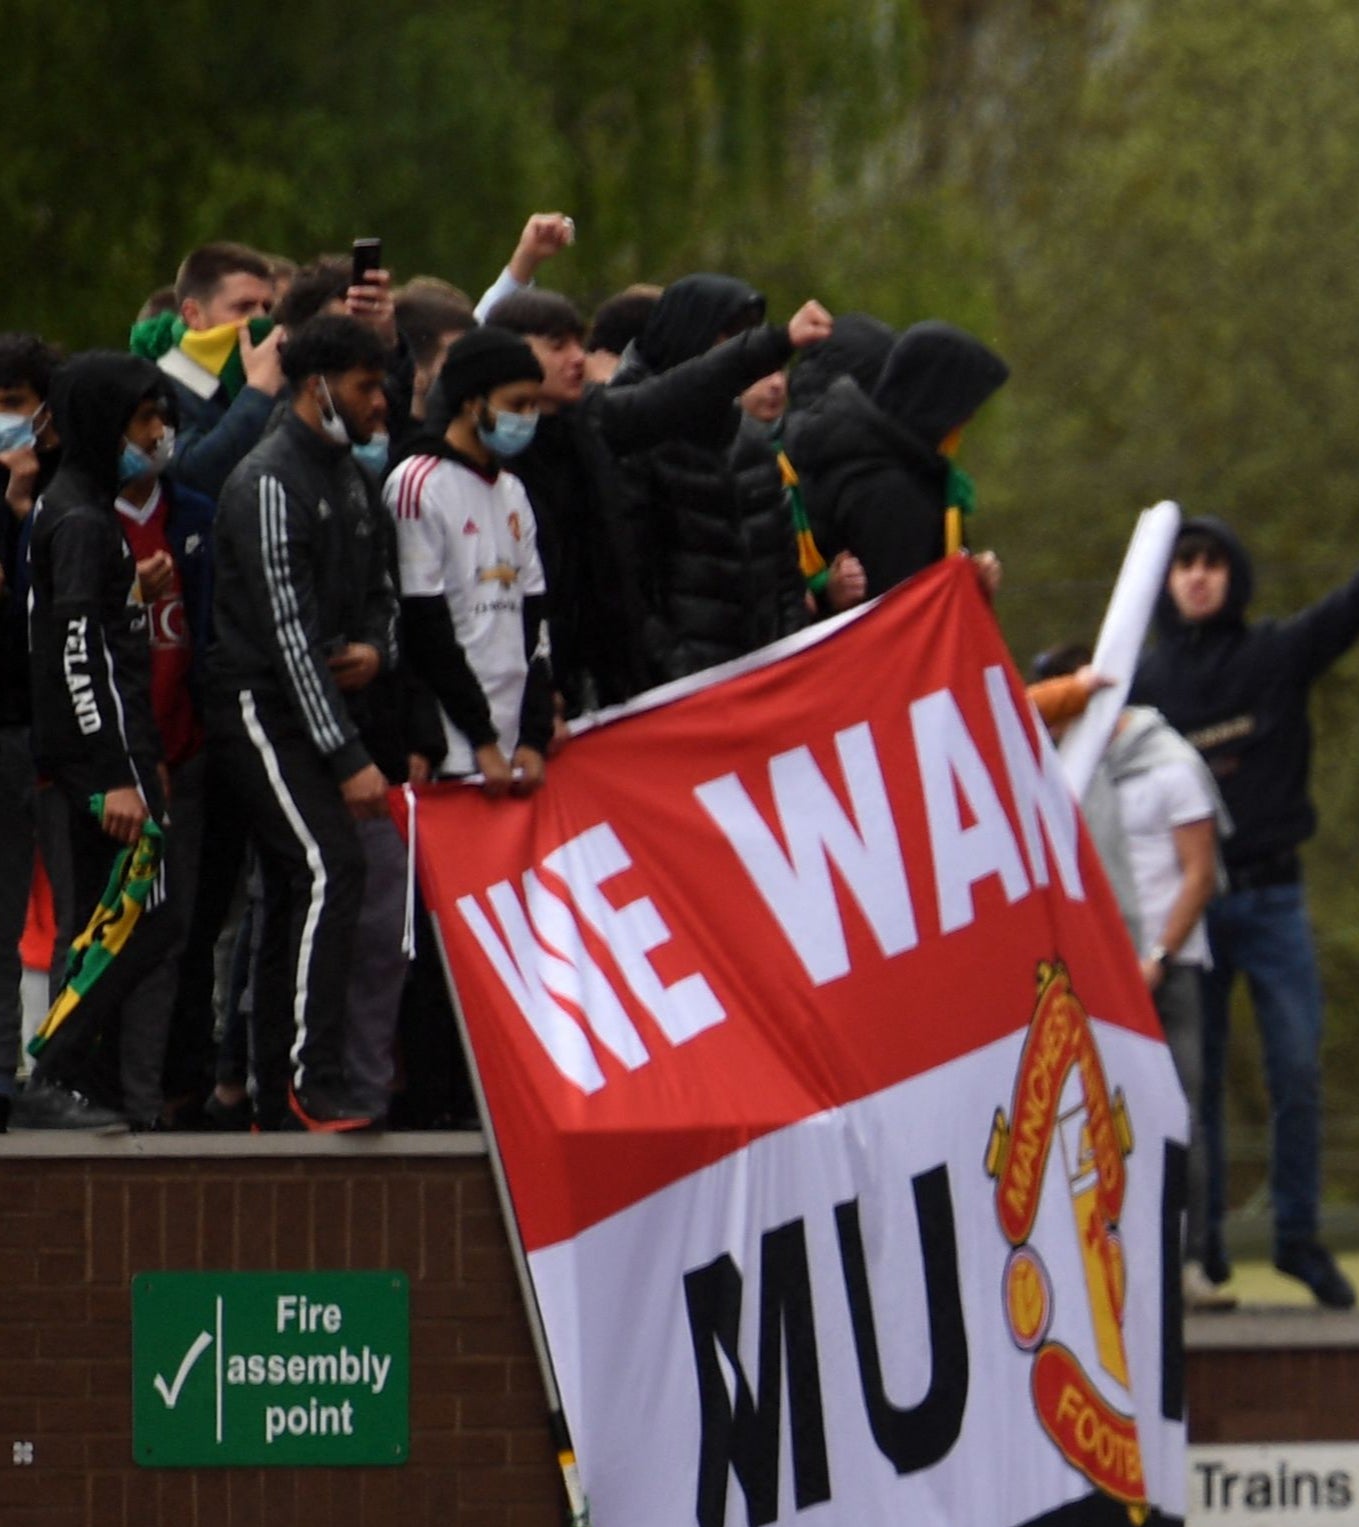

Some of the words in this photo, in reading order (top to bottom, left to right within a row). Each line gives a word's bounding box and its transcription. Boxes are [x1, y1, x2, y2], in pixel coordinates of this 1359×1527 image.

[456, 821, 727, 1096] WE
[276, 1294, 343, 1334] Fire
[226, 1346, 392, 1395] assembly
[265, 1396, 354, 1445] point
[1195, 1460, 1354, 1511] Trains
